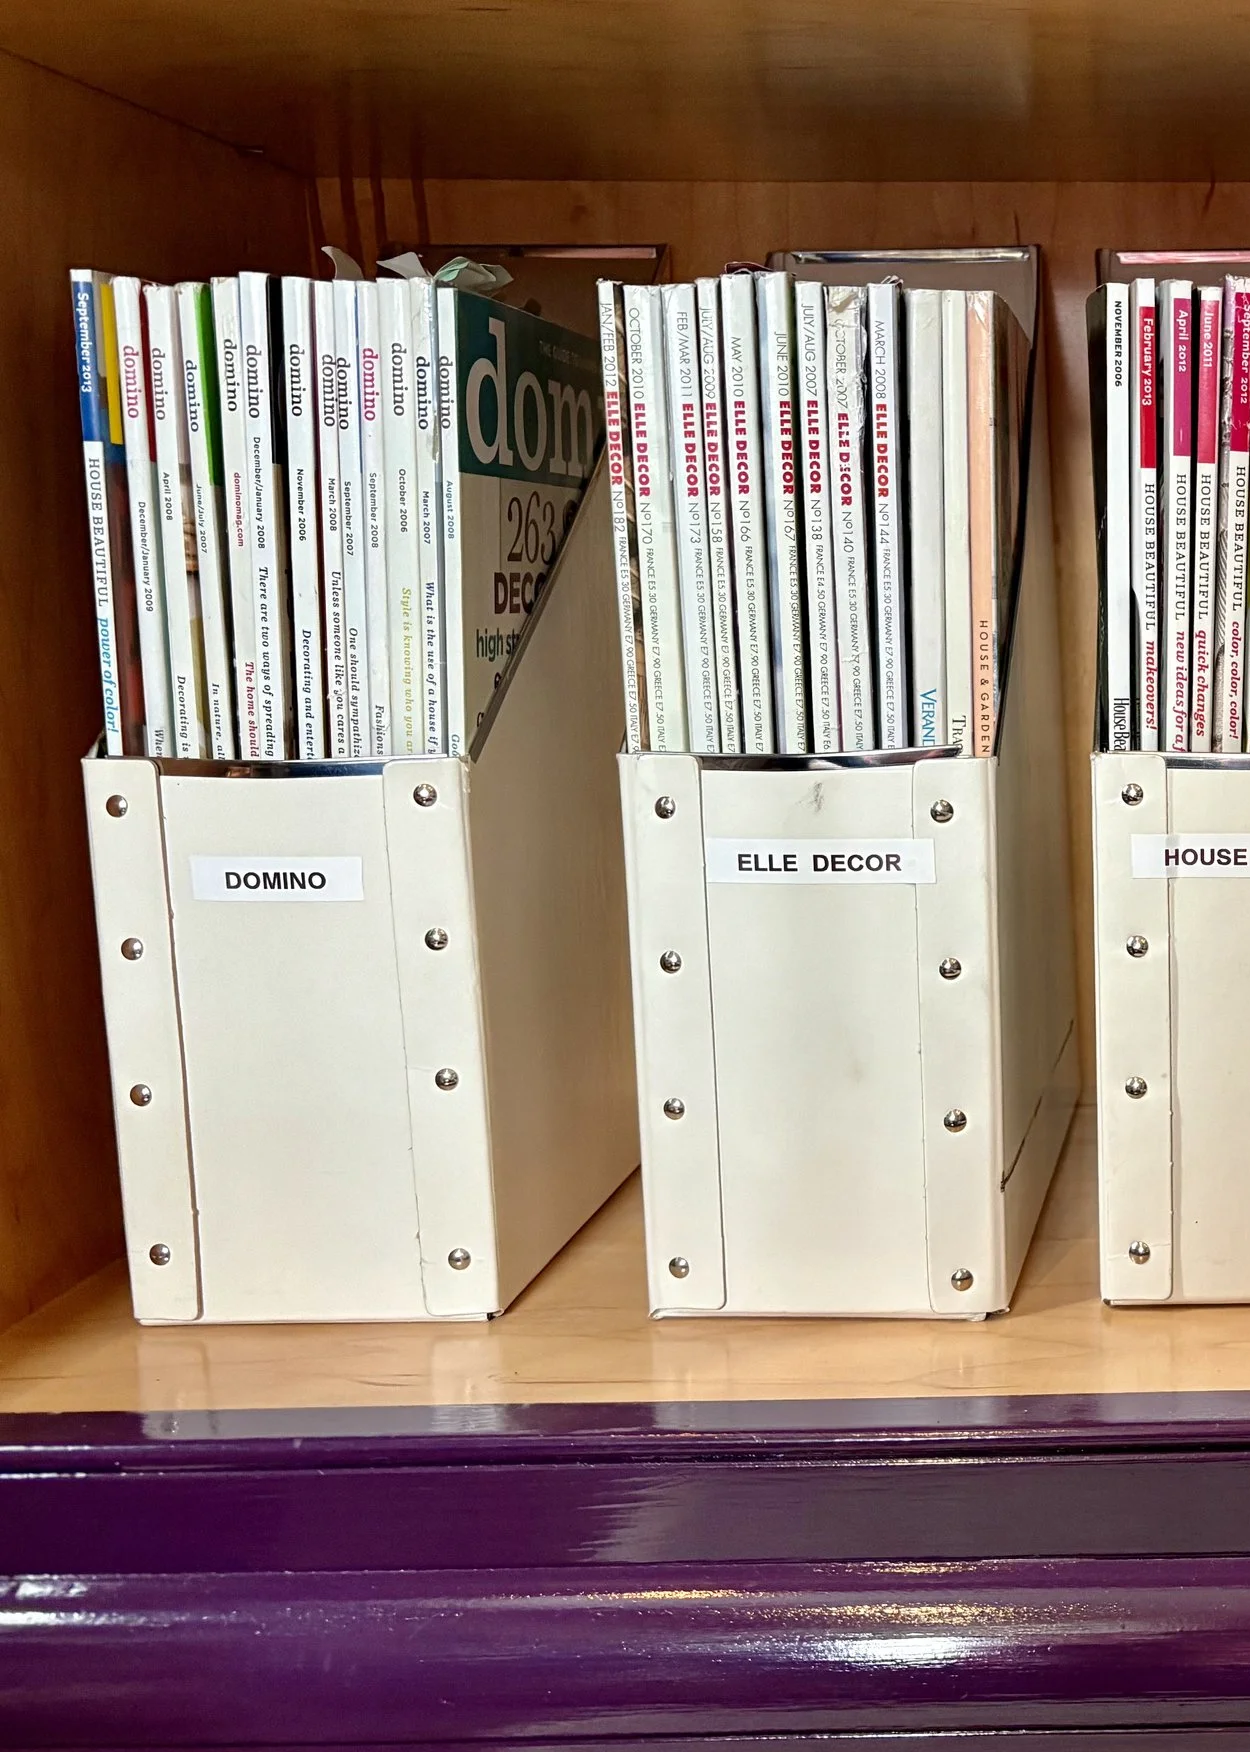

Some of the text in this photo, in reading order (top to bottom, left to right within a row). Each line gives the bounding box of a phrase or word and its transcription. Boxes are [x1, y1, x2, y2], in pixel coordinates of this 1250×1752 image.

[875, 321, 885, 364] MARCH
[123, 346, 140, 418] domino
[185, 360, 200, 432] domino
[246, 345, 263, 418] domino
[289, 344, 306, 416] domino
[321, 355, 337, 427] domino
[336, 358, 352, 430] domino
[362, 348, 379, 421] domino
[391, 343, 408, 416] domino
[416, 356, 431, 430] domino
[439, 356, 454, 429] domino
[629, 308, 651, 497] OCTOBER 2010 ELLE DECOR
[731, 337, 749, 494] MAY 2010 ELLE DECOR
[775, 332, 794, 494] JUNE 2010 ELLE DECOR
[875, 369, 886, 399] 2008
[152, 348, 173, 520] domino April 2008
[606, 392, 623, 485] ELLE DECOR
[682, 404, 698, 497] ELLE DECOR
[705, 402, 720, 496] ELLE DECOR
[807, 400, 821, 493] ELLE DECOR
[876, 404, 887, 438] ELLE
[253, 437, 264, 522] December/January
[877, 443, 889, 497] DECOR
[76, 293, 118, 733] September 2013 HOUSE BEAUTIFUL power of color!
[223, 339, 259, 757] domino dominomag.com The home should
[257, 525, 265, 548] 2008
[1142, 318, 1157, 730] February 2013 HOUSE BEAUTIFUL makeovers!
[1195, 310, 1213, 736] June 2011 HOUSE BEAUTIFUL quick changes
[259, 567, 269, 599] There
[882, 549, 891, 579] FRANCE
[260, 604, 268, 621] are
[884, 606, 893, 644] GERMANY
[263, 652, 272, 680] ways
[263, 685, 274, 697] of
[886, 671, 894, 700] GREECE
[979, 621, 990, 753] HOUSE & GARDEN
[263, 700, 275, 756] spreading
[887, 726, 896, 742] ITALY
[224, 870, 327, 892] DOMINO
[736, 852, 903, 874] ELLE DECOR
[1164, 848, 1248, 867] HOUSE
